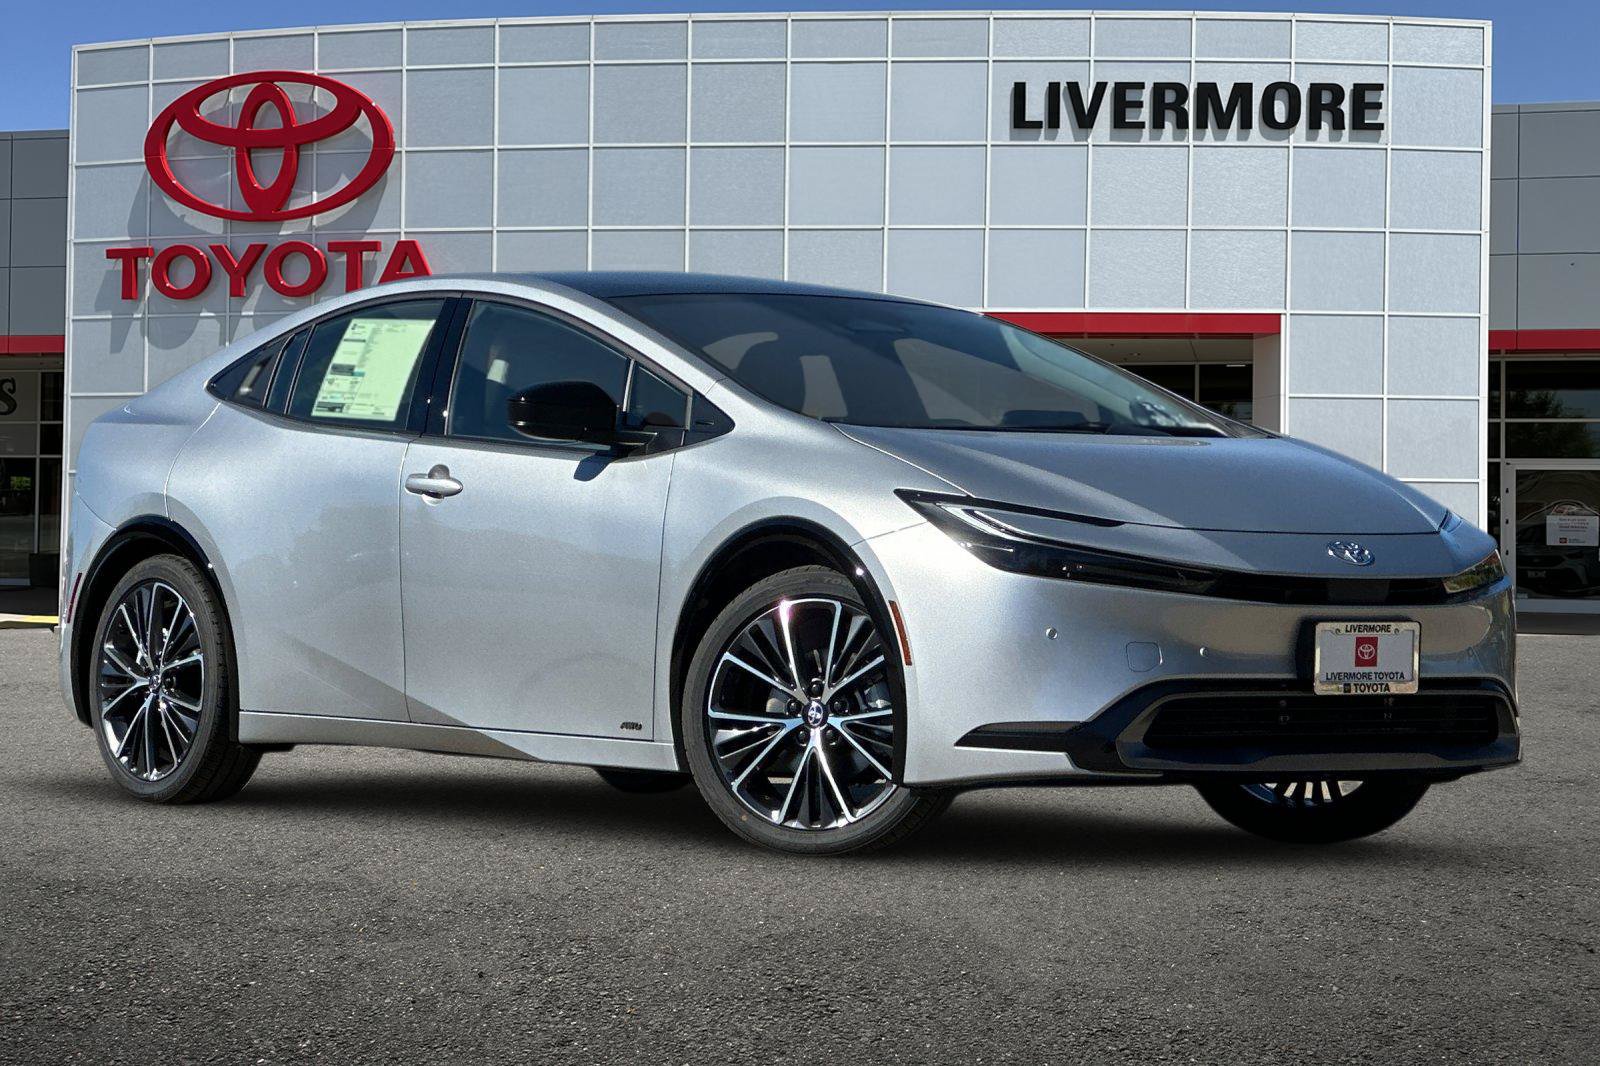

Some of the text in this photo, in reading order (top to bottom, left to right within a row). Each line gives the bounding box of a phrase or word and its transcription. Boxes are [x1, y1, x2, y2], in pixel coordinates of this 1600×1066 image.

[1013, 81, 1384, 131] LIVERMORE
[106, 240, 432, 300] TOYOTA
[1345, 624, 1391, 633] LIVERMORE
[1326, 671, 1405, 681] LIVERMORE TOYOTA
[1354, 683, 1390, 693] TOYOTA
